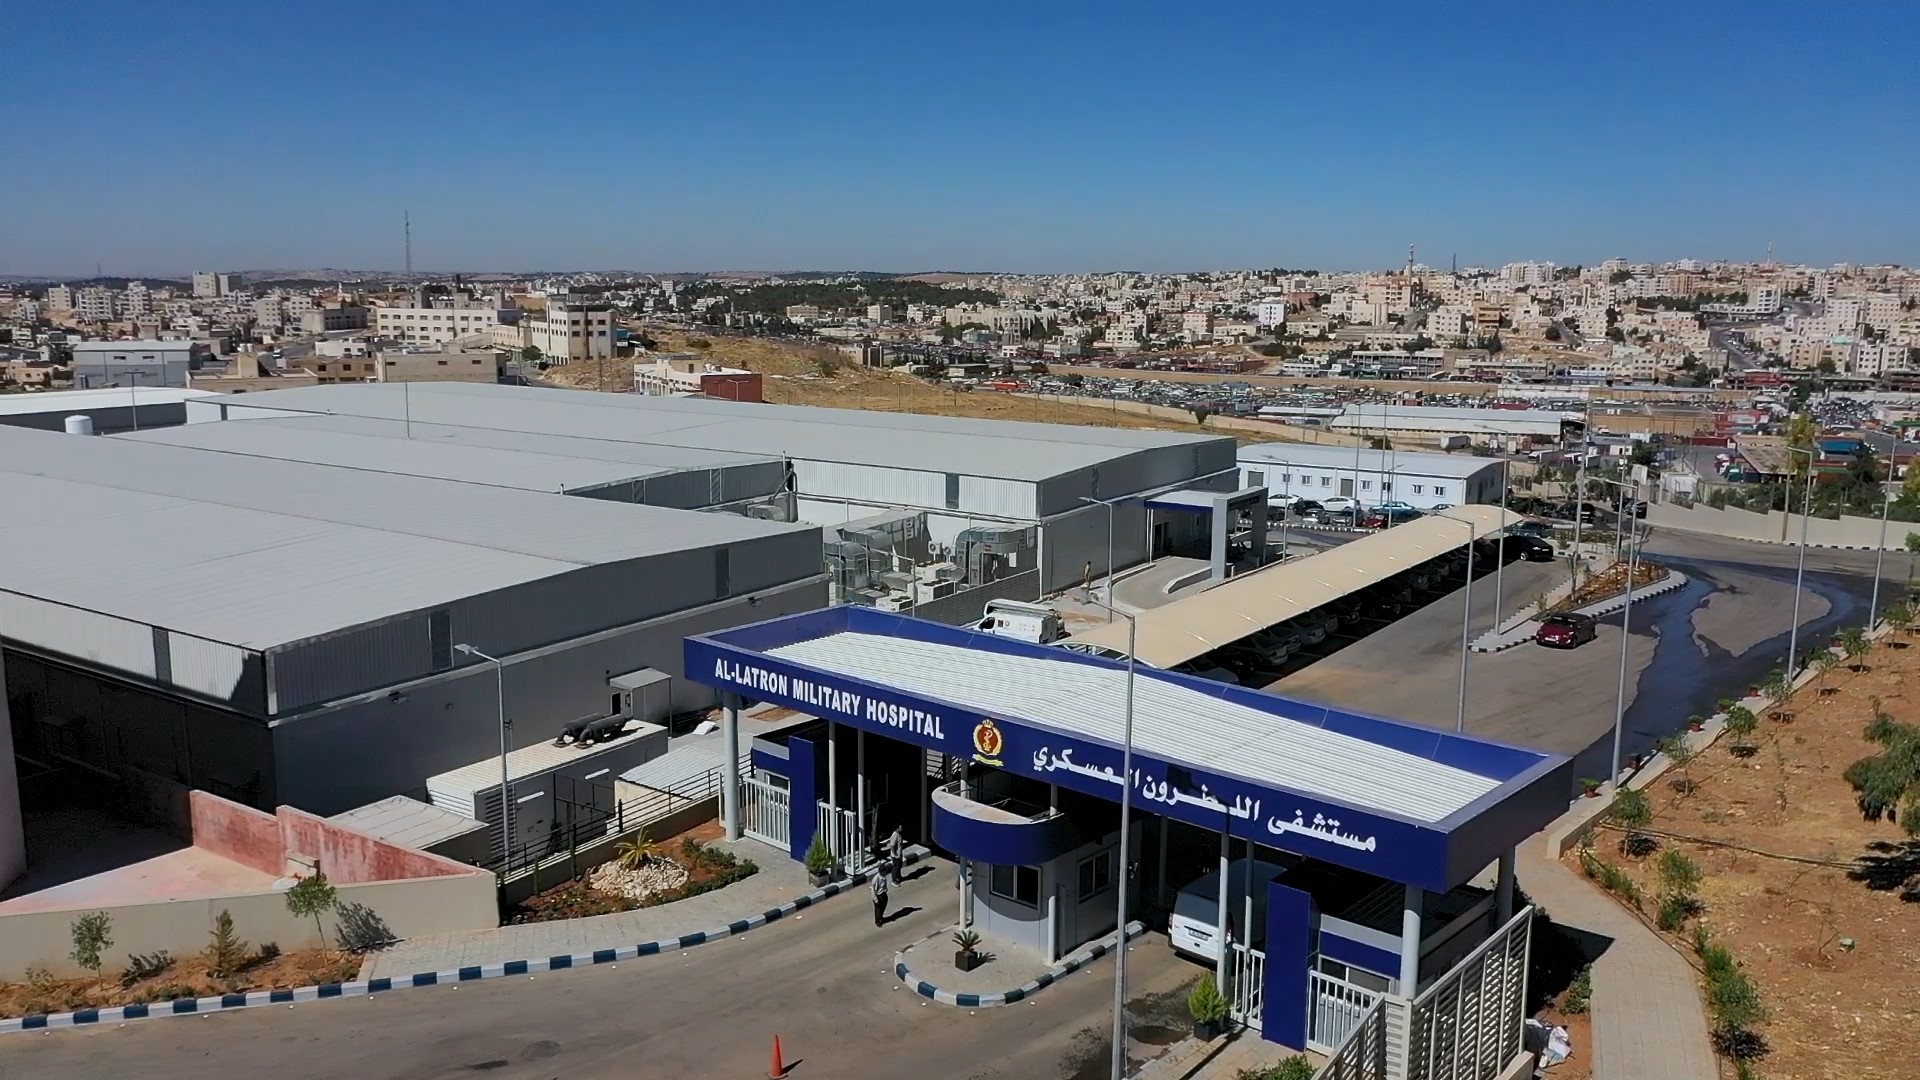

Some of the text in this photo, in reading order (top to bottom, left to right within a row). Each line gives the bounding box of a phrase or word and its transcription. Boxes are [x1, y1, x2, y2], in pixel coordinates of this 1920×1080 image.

[715, 658, 945, 740] AL-LATRON MILITARY HOSPITAL
[1267, 809, 1376, 853] مستشفى
